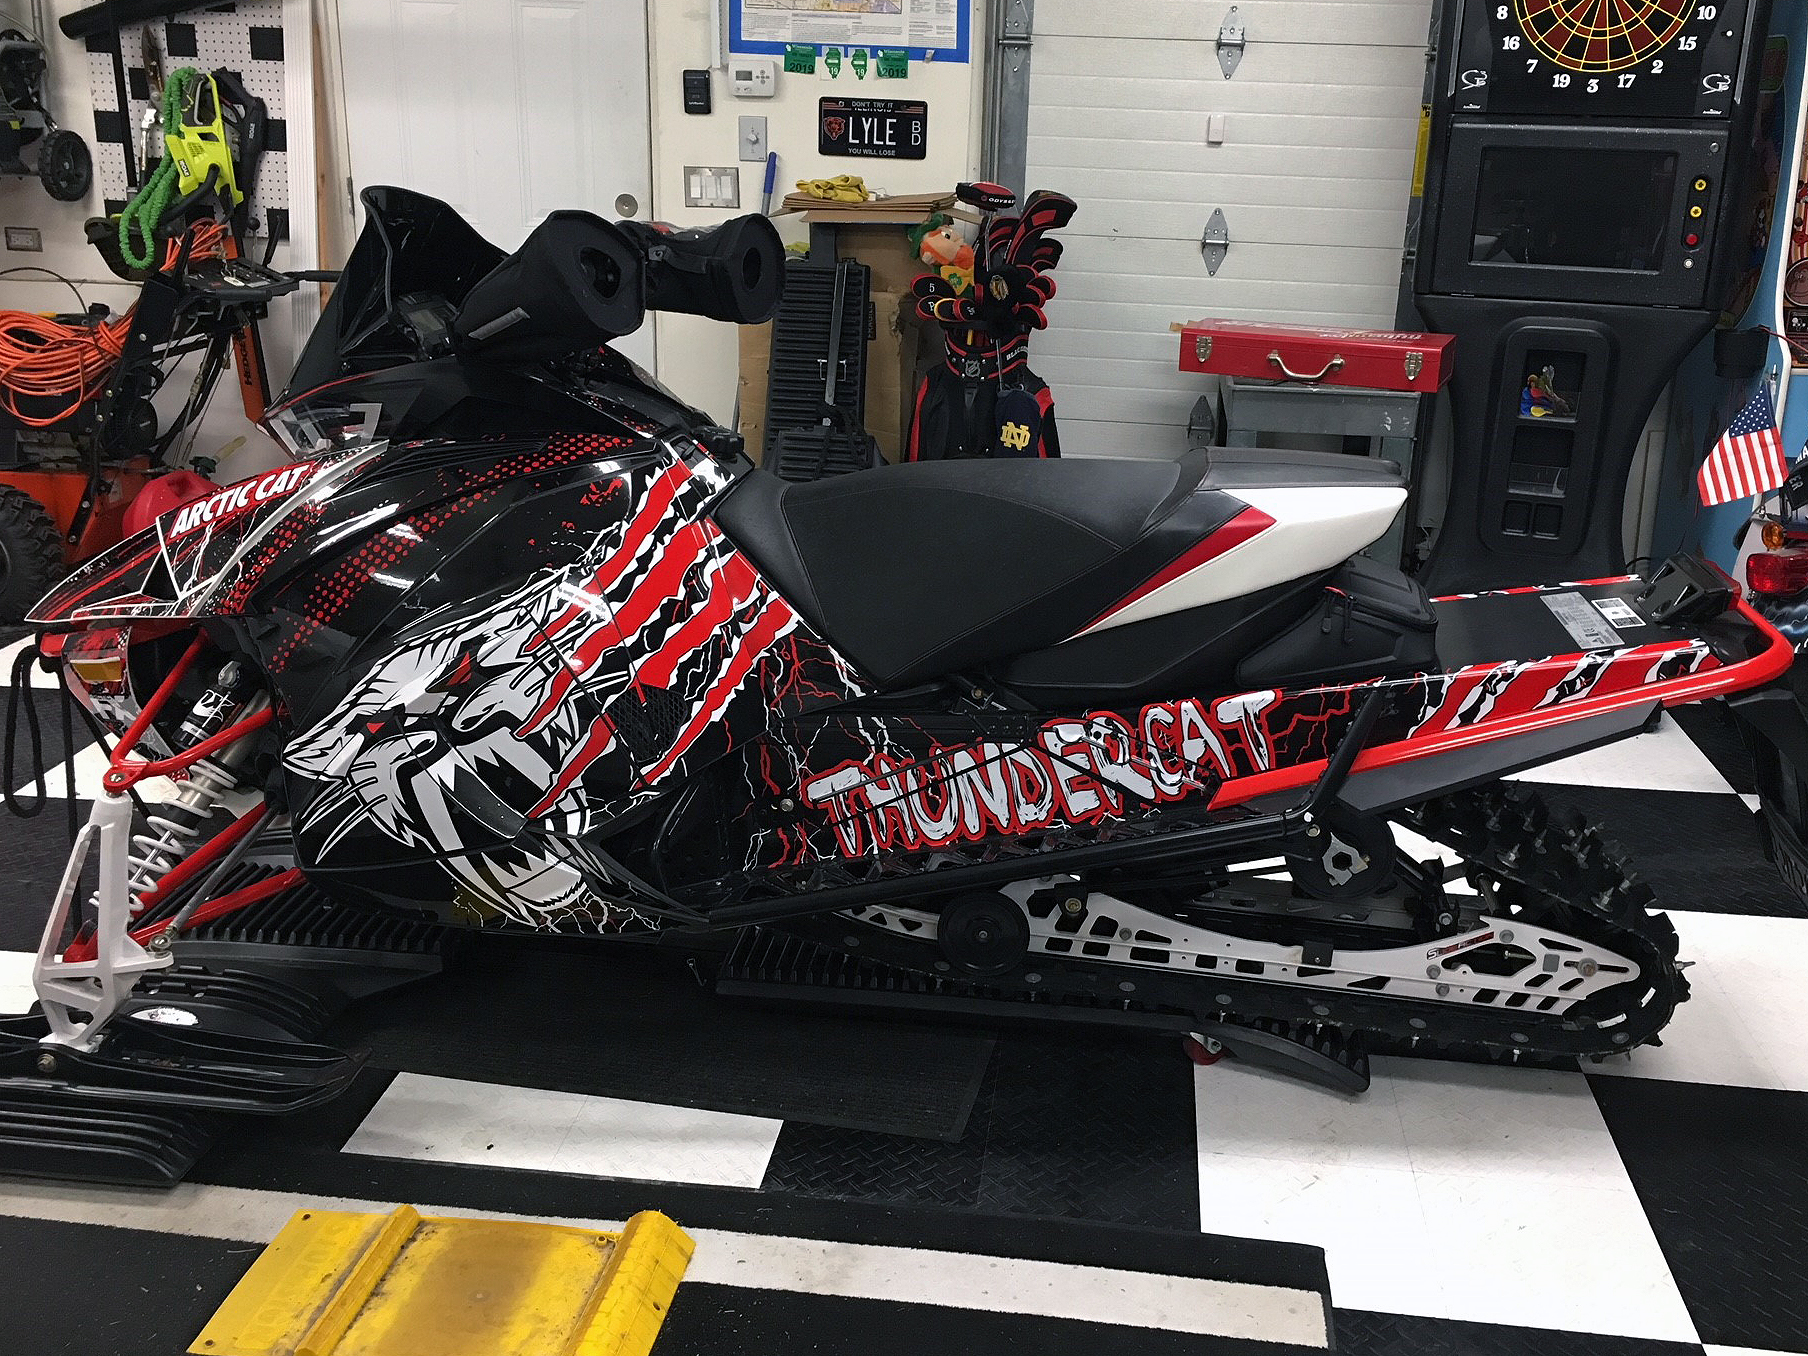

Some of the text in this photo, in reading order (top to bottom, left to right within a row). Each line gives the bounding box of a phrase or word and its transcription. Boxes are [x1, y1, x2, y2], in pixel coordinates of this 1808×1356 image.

[1496, 5, 1508, 20] 8
[1696, 5, 1717, 20] 10
[1502, 35, 1520, 50] 16
[1677, 35, 1698, 51] 15
[789, 62, 814, 74] 2019
[830, 67, 838, 76] 19
[856, 68, 865, 77] 19
[881, 68, 907, 78] 2019
[1526, 58, 1538, 73] 7
[1650, 59, 1664, 74] 2
[1552, 73, 1571, 88] 19
[1586, 78, 1600, 93] 3
[1617, 73, 1636, 88] 17
[848, 116, 897, 146] LYLE
[911, 120, 921, 133] B
[911, 133, 921, 146] D
[847, 147, 862, 155] YOU
[862, 148, 878, 156] WILL
[929, 282, 935, 293] 5
[169, 464, 310, 539] ARCTIC CAT
[804, 688, 1281, 858] THUNDERCAT
